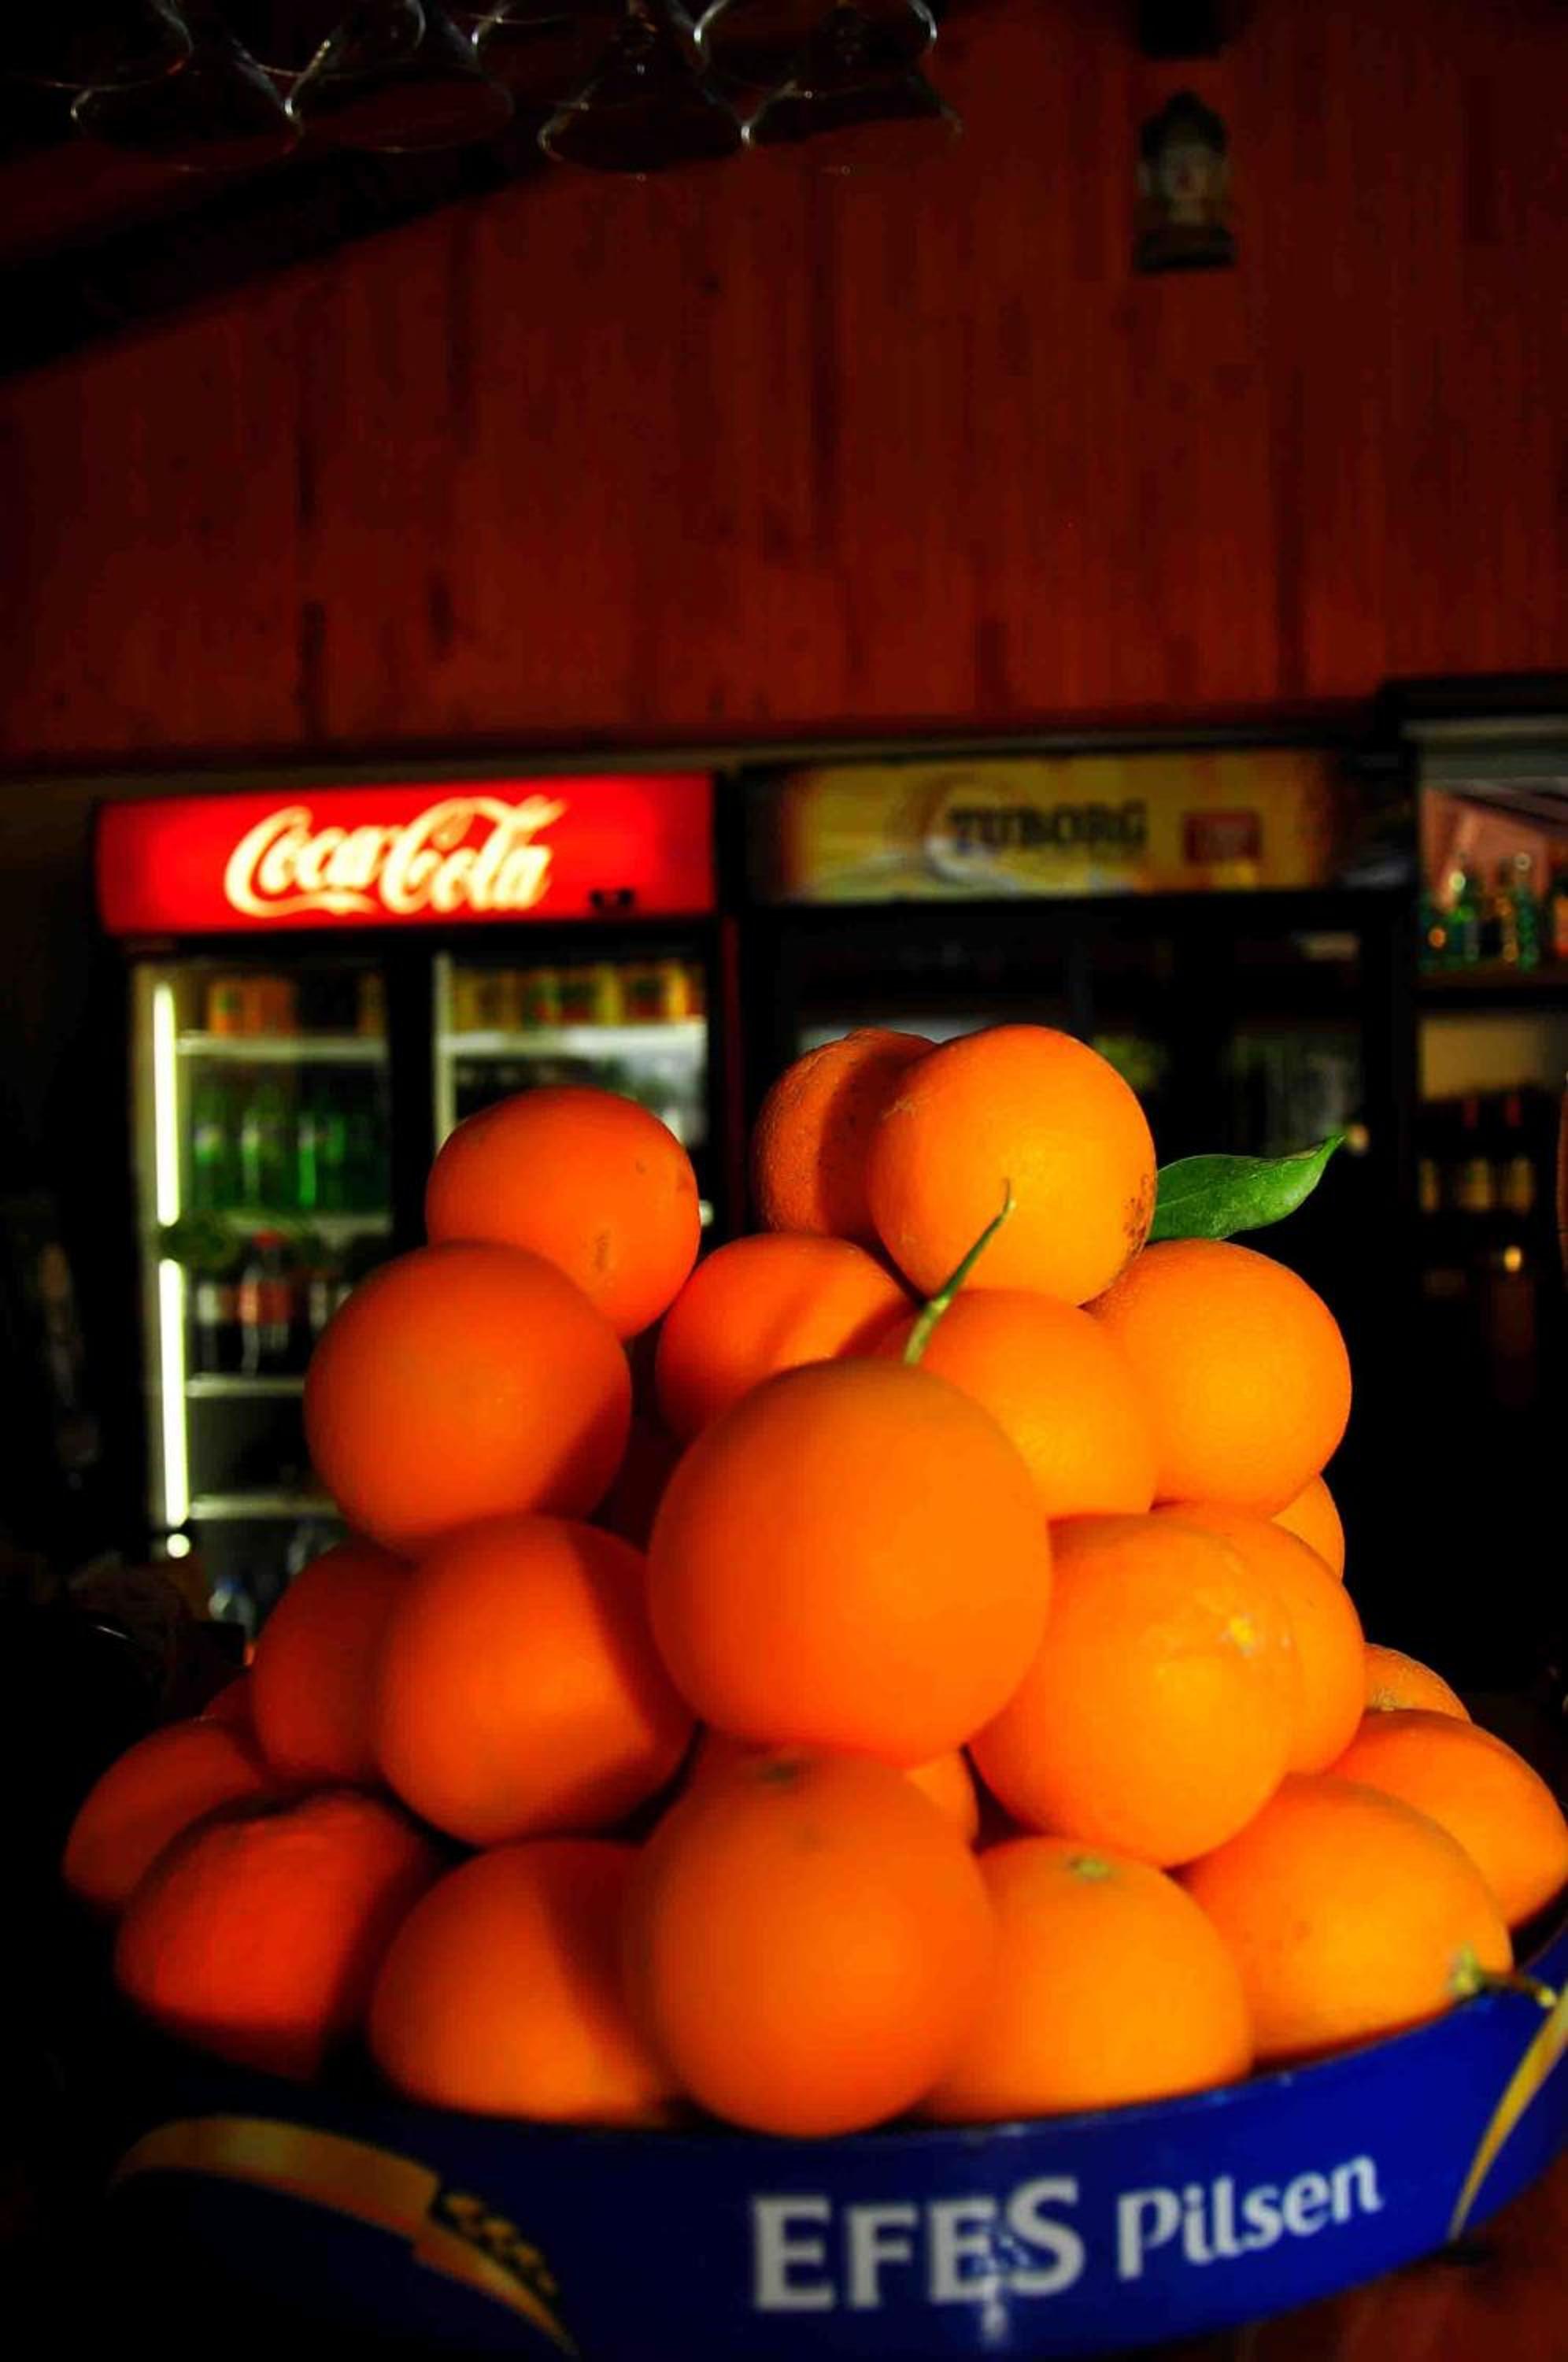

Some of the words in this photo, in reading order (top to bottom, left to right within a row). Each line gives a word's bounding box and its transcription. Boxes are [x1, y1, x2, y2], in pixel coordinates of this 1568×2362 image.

[949, 800, 1148, 852] TUBORG
[750, 2176, 1086, 2311] EFES
[1118, 2154, 1383, 2282] Pilsen
